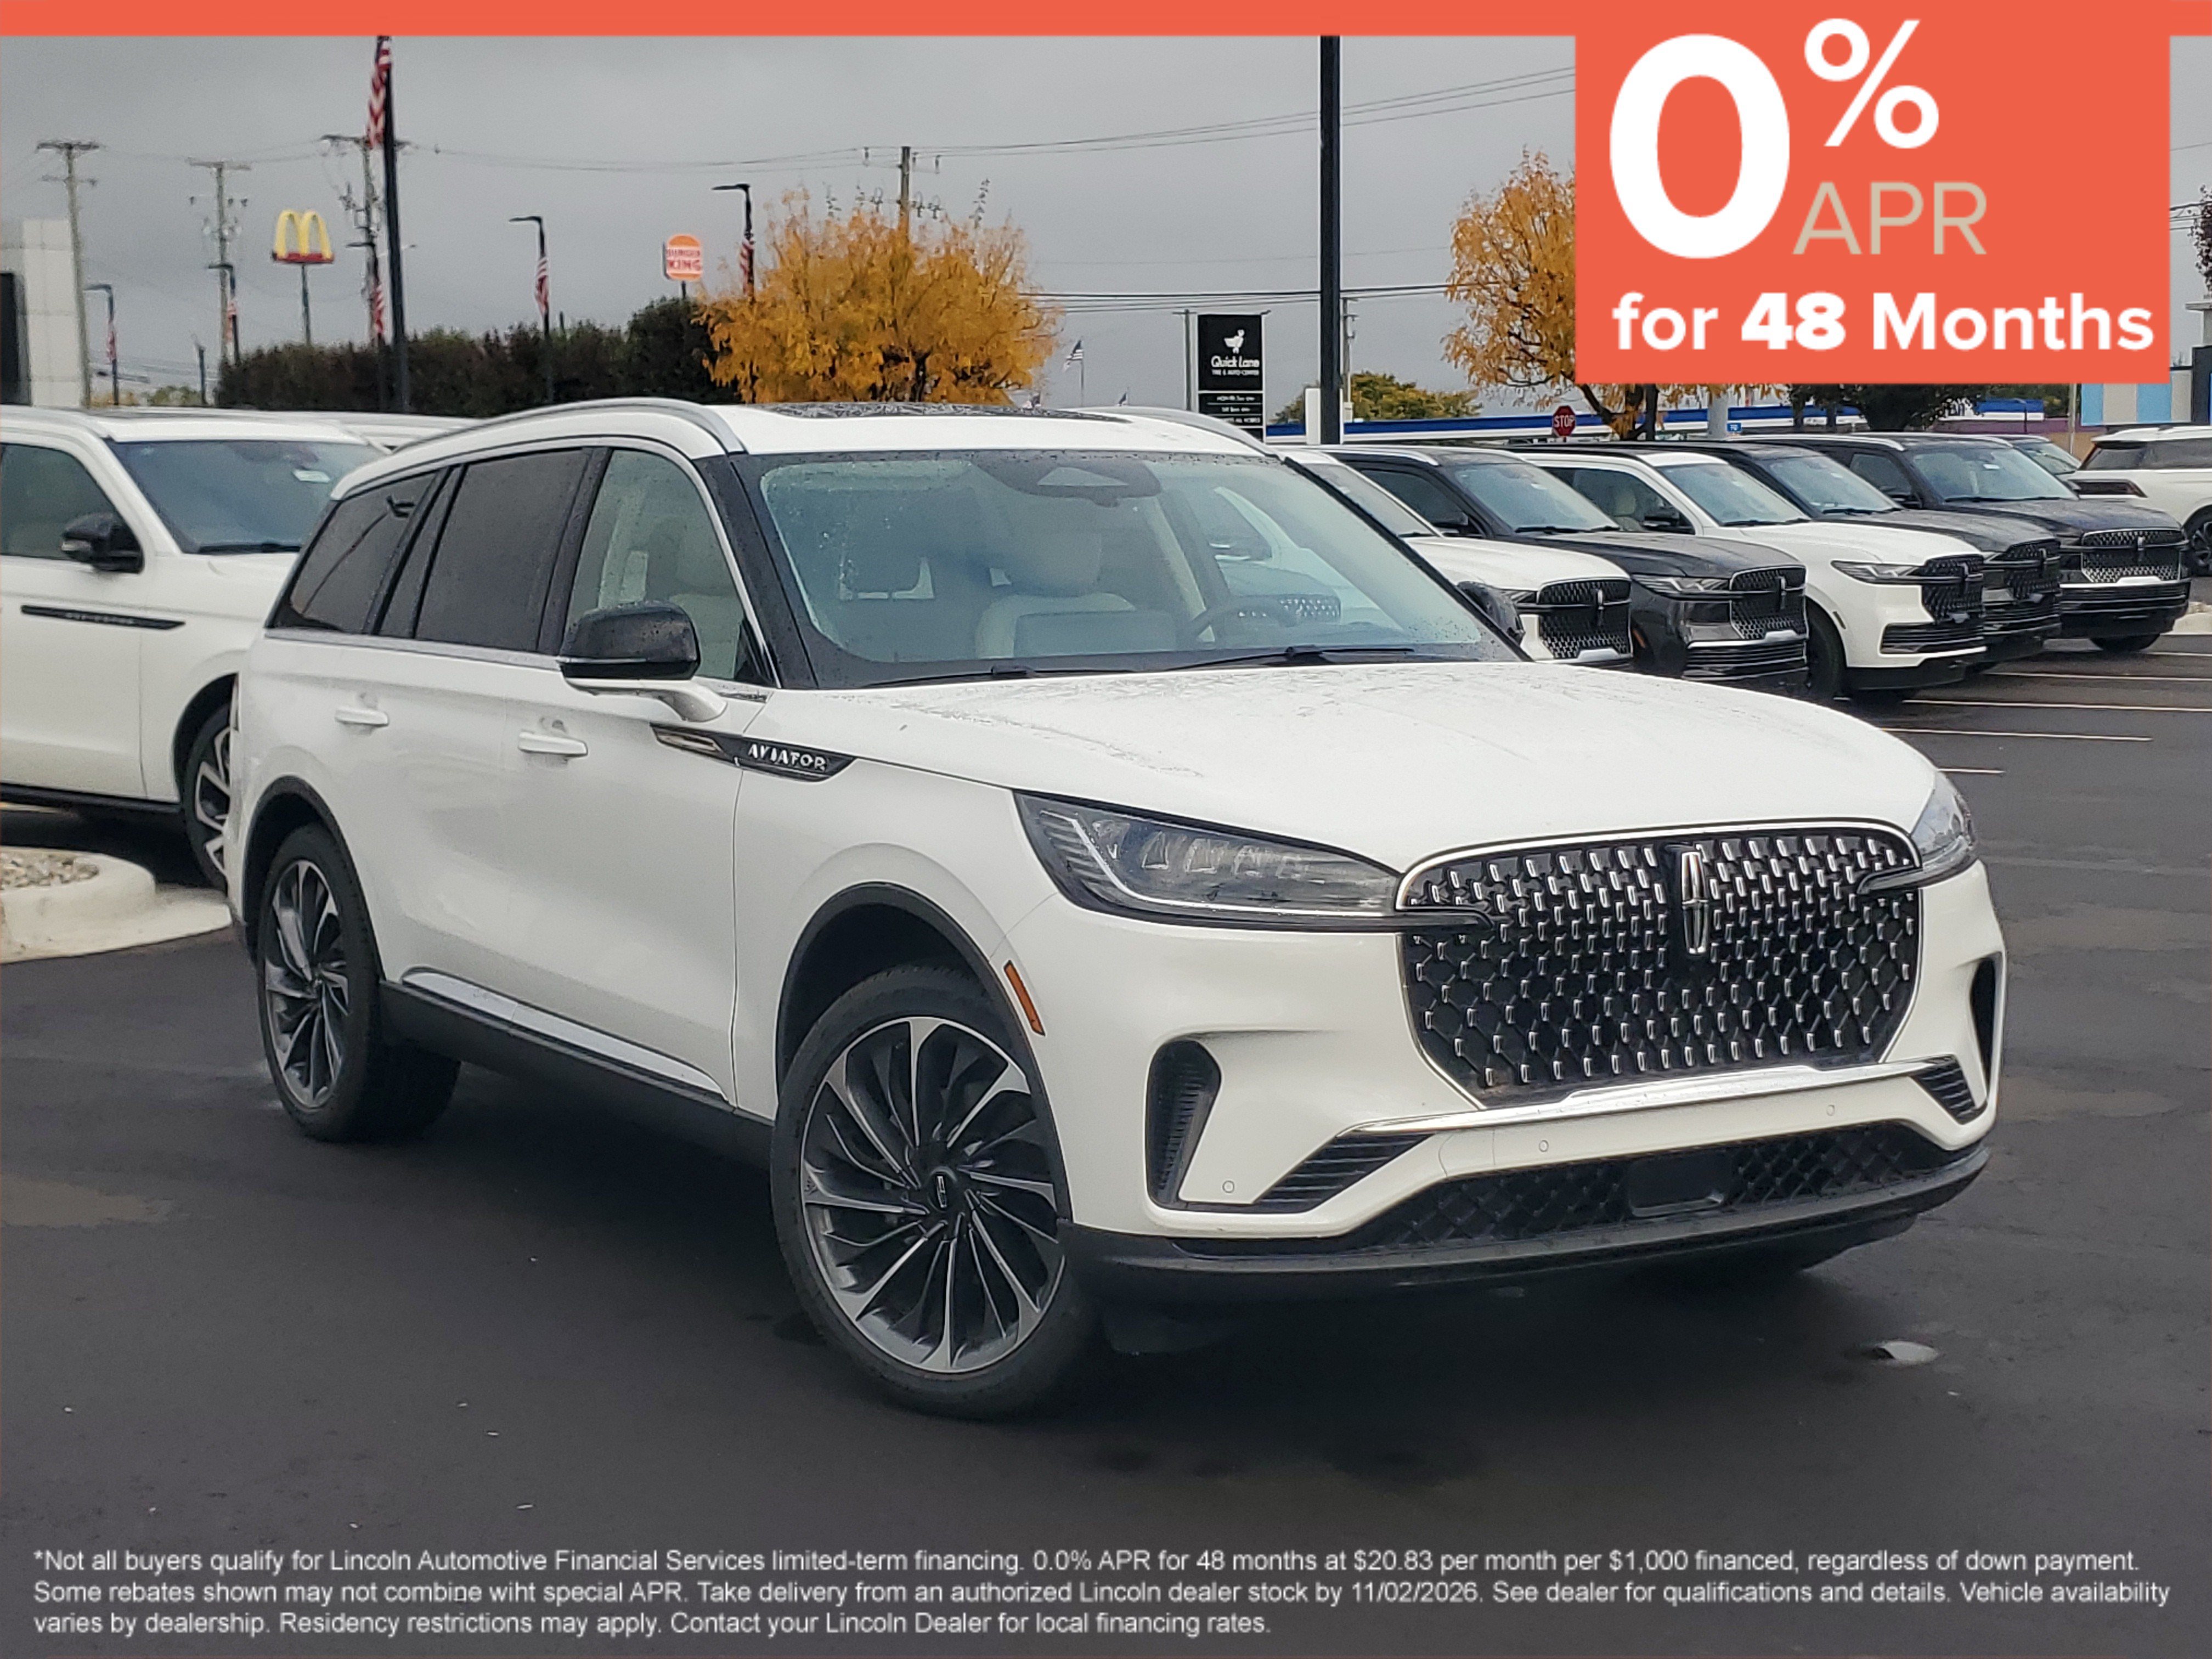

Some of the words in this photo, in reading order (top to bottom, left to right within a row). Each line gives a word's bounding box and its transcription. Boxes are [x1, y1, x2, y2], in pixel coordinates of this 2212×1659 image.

[667, 259, 701, 271] KING
[1211, 355, 1238, 368] Quick
[1238, 356, 1260, 368] Lane
[1554, 414, 1575, 427] STOP
[748, 743, 825, 771] AVIATOR
